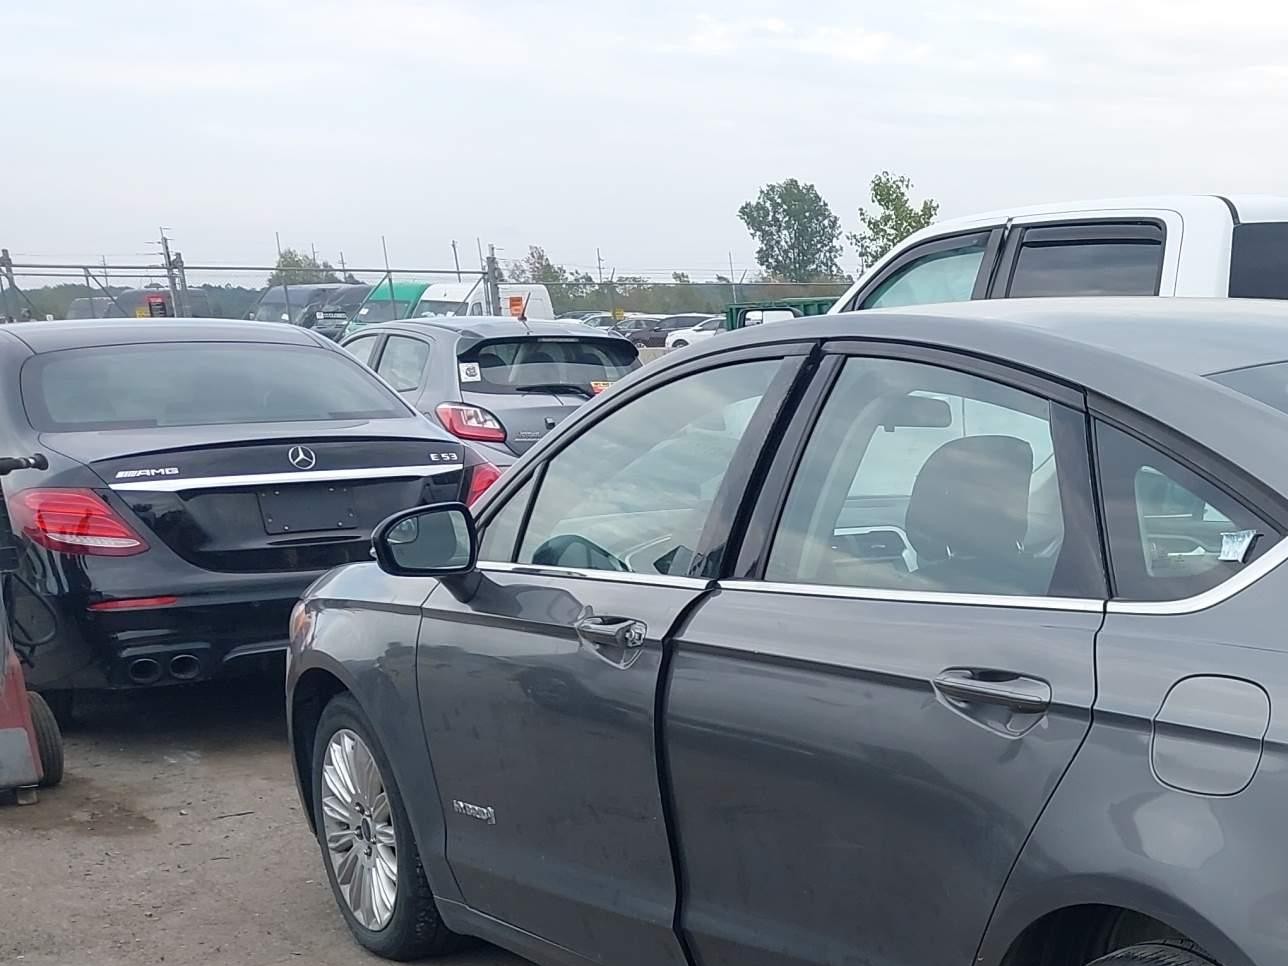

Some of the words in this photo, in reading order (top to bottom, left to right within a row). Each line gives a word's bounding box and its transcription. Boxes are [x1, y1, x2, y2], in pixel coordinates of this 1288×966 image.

[429, 453, 440, 461] E
[440, 452, 458, 461] 53
[135, 467, 179, 477] AMG
